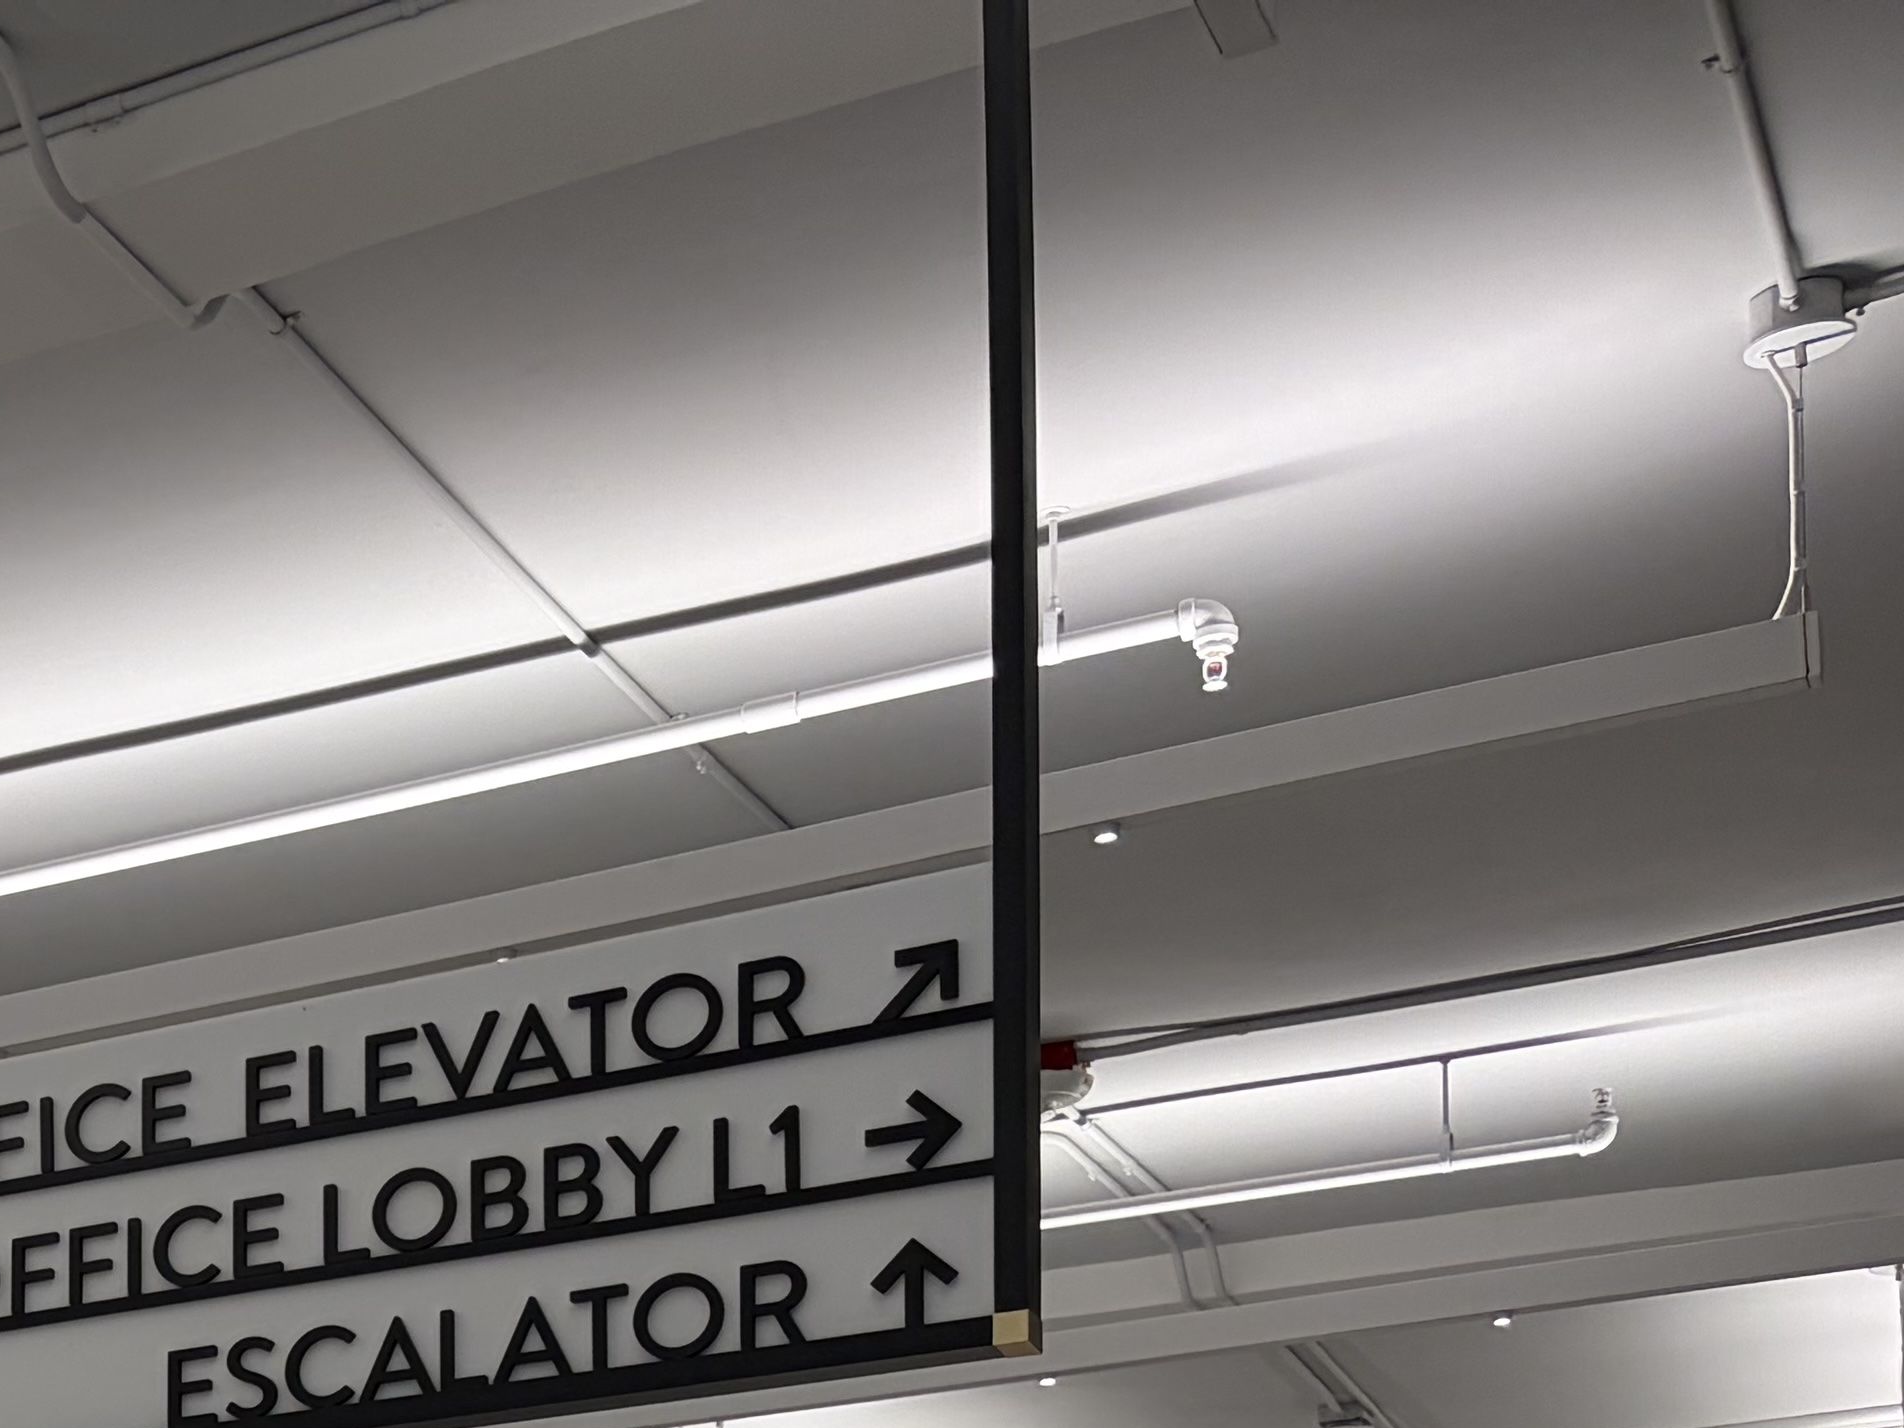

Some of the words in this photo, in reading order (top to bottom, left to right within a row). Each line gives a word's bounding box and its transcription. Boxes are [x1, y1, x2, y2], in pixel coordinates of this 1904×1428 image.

[245, 956, 807, 1137] ELEVATOR
[323, 1125, 681, 1264] LOBBY
[712, 1105, 801, 1204] L1
[167, 1260, 808, 1428] ESCALATOR
